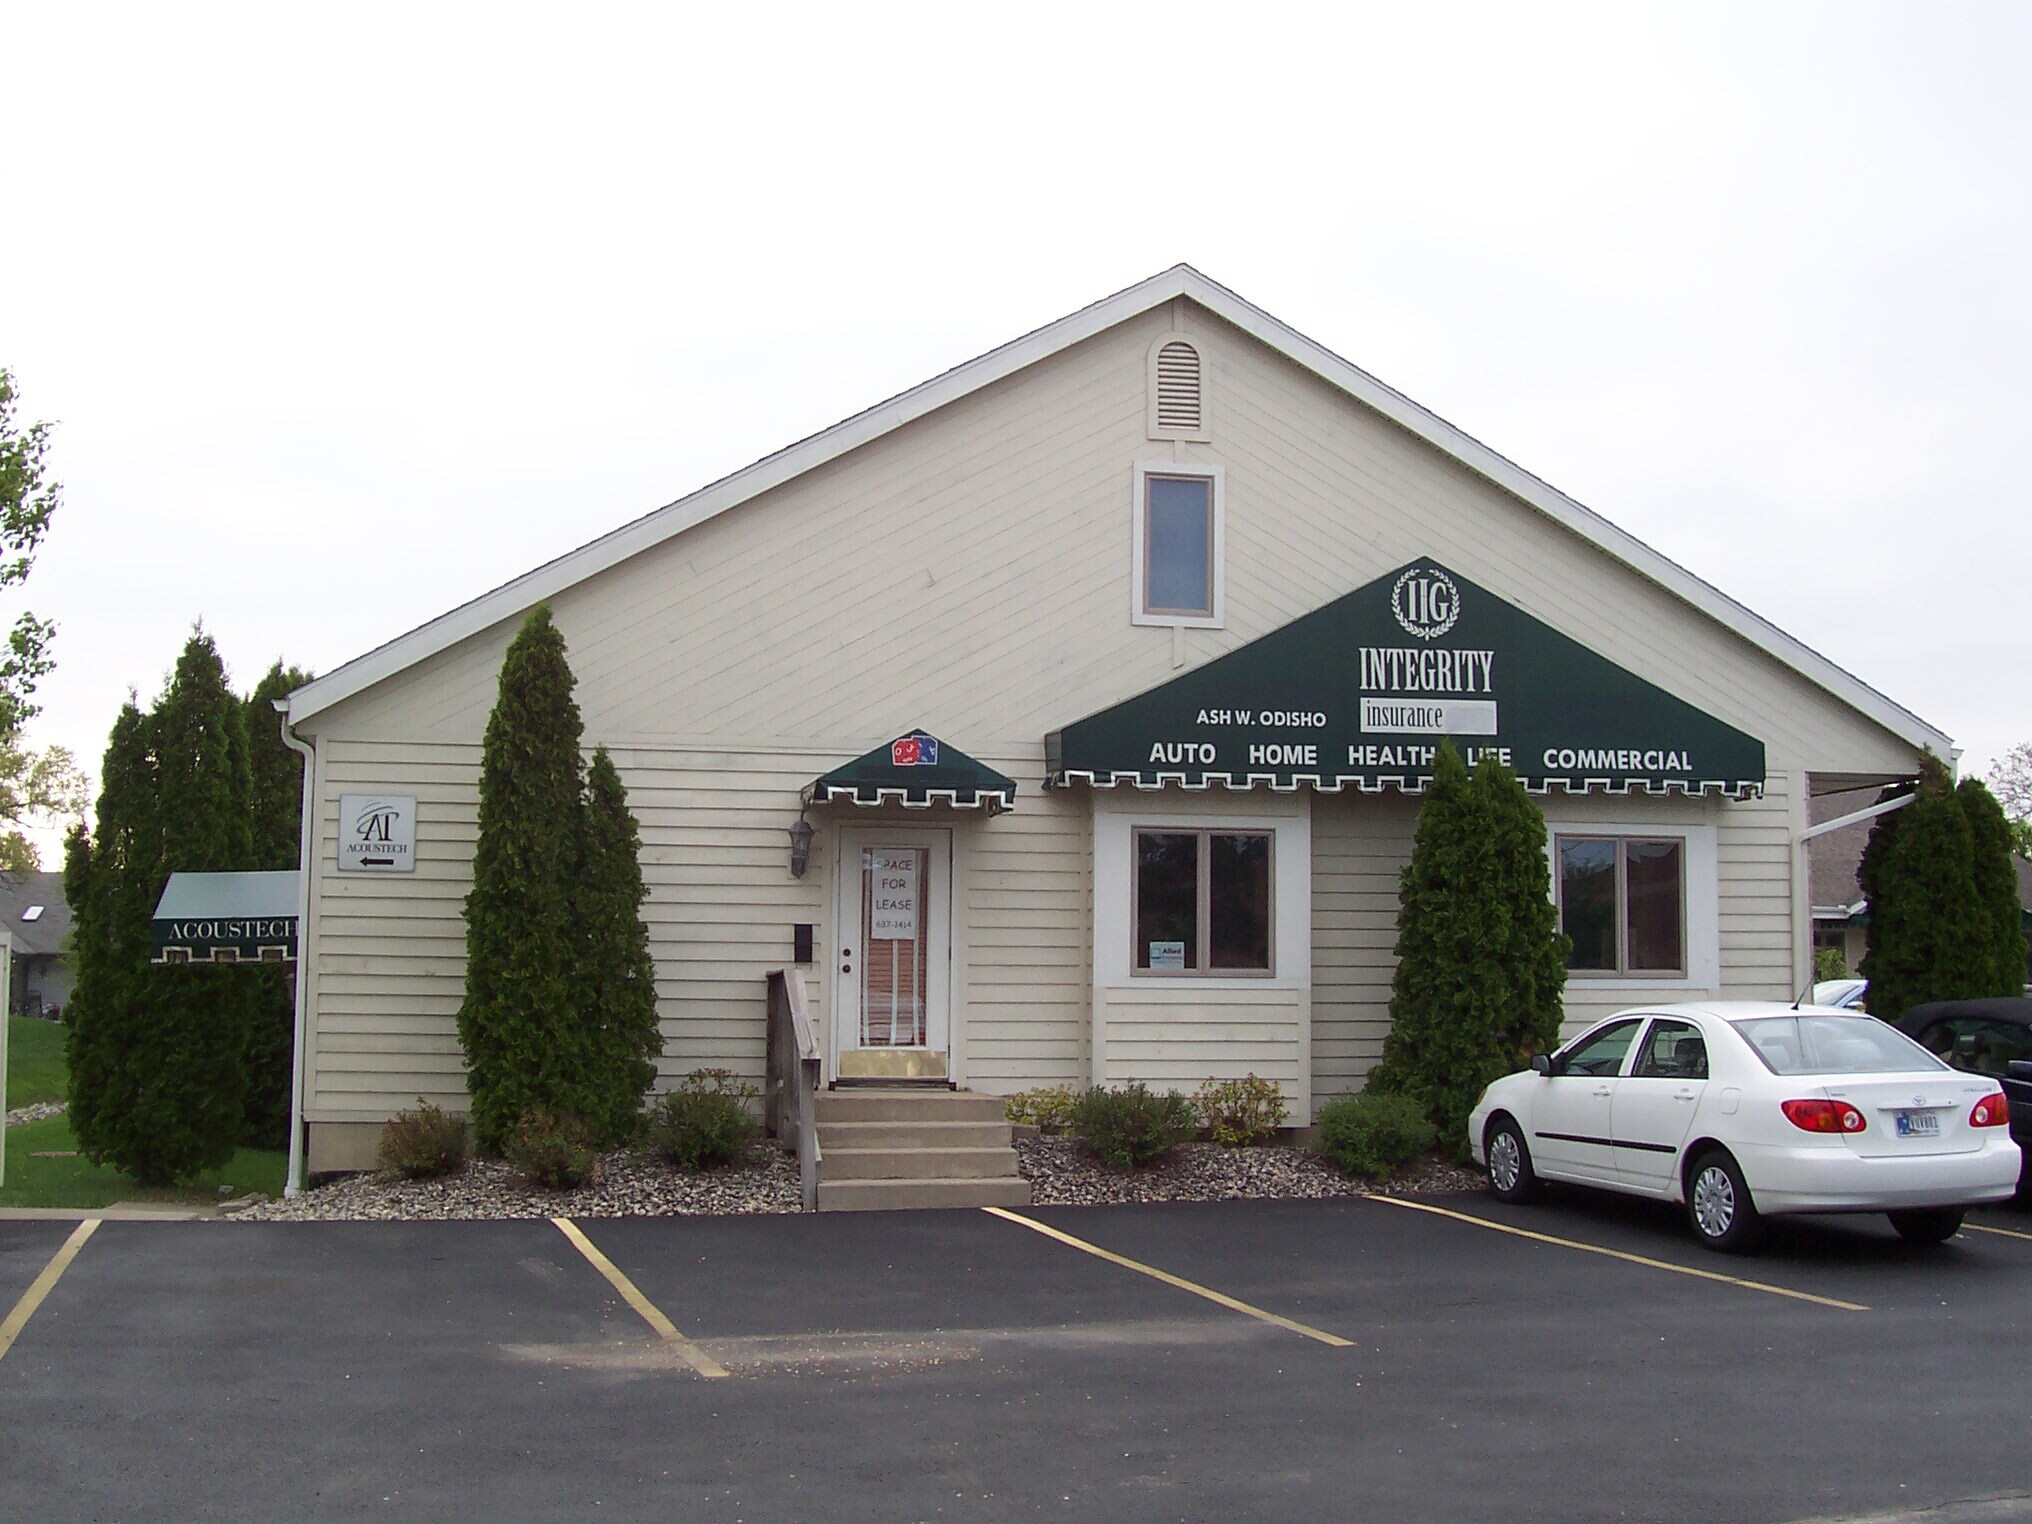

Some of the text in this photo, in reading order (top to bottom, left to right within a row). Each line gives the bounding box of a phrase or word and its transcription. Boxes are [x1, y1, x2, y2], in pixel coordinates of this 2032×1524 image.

[1358, 647, 1495, 693] INTEGRITY
[1196, 709, 1327, 728] ASH W. ODISHO
[1366, 701, 1444, 729] insurance
[1149, 744, 1693, 771] AUTO HOME HEALTH LIFE COMMERCIAL
[346, 844, 408, 854] ACOUSTECH
[881, 878, 907, 890] FOR
[875, 899, 912, 911] LEASE
[168, 920, 298, 939] ACOUSTECH
